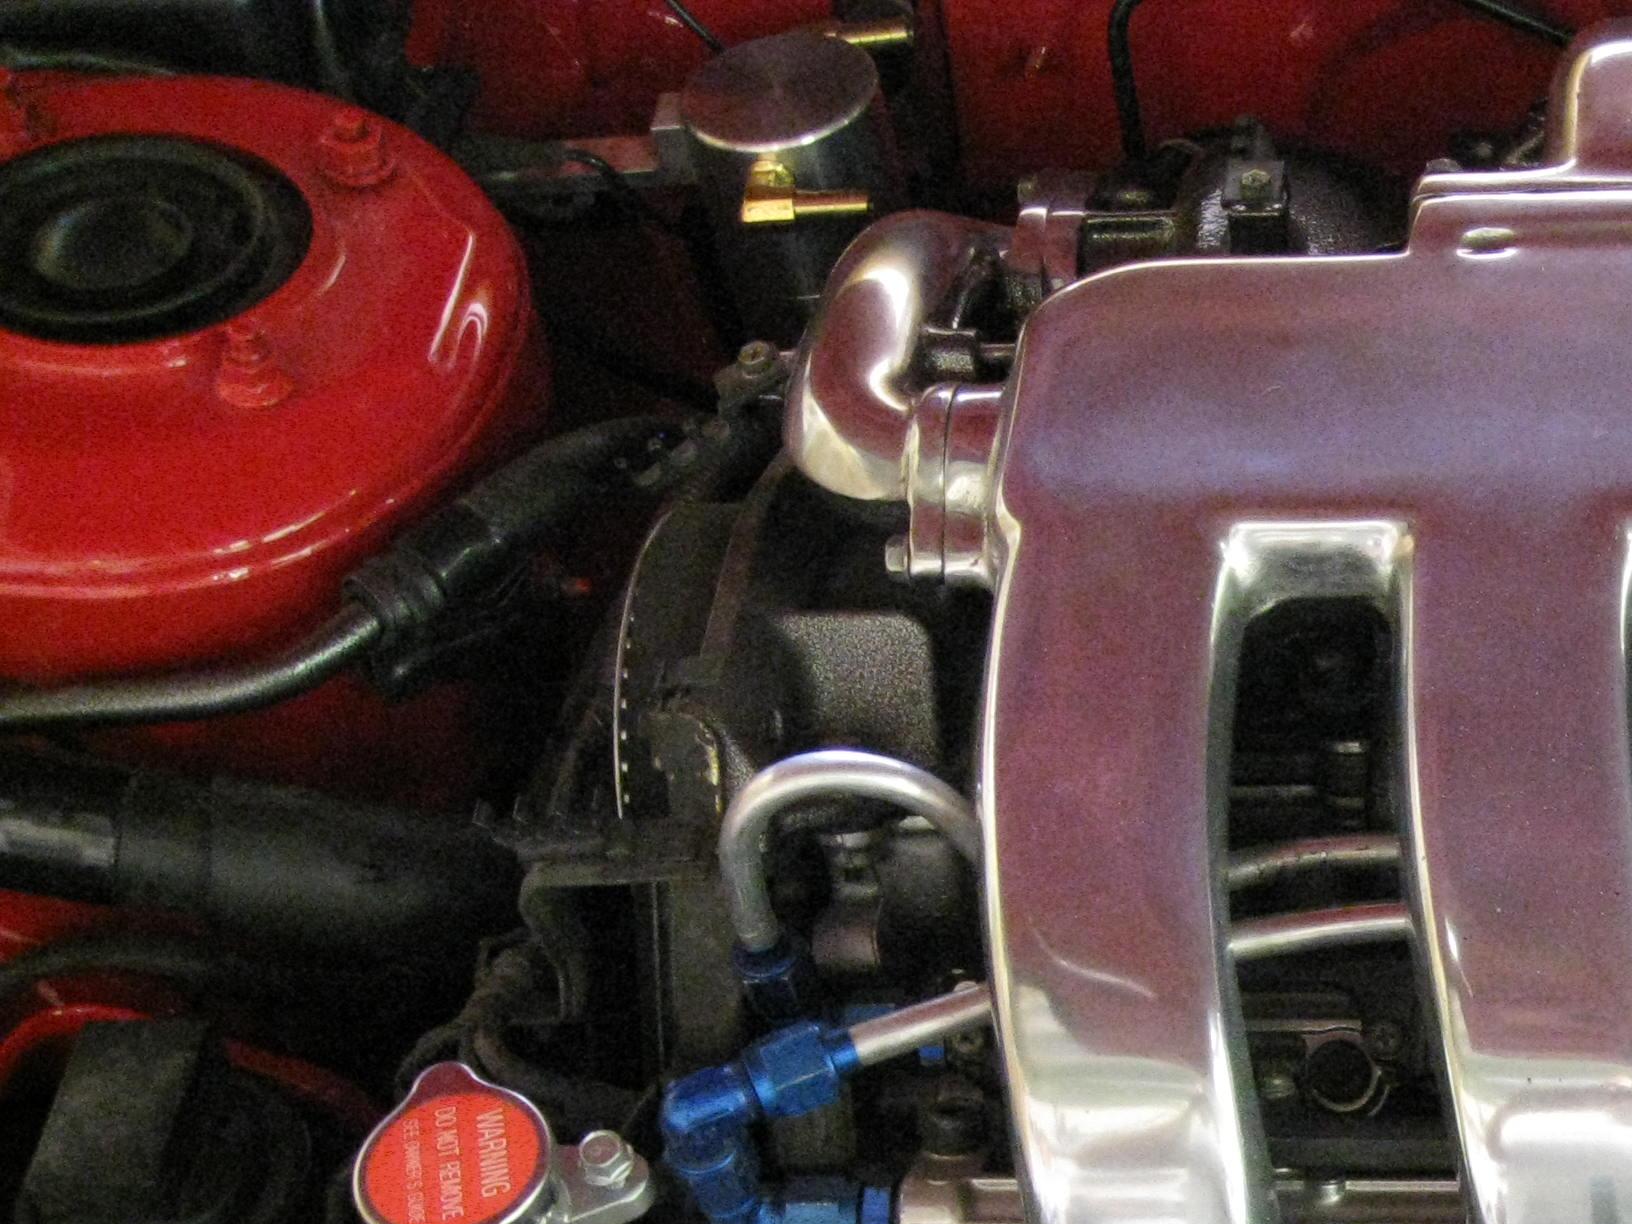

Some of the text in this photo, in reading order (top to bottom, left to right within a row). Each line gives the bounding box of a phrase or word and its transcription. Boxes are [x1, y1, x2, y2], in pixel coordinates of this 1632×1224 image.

[402, 1118, 420, 1140] SEE
[434, 1106, 465, 1221] DO NOT REMOVE
[476, 1108, 512, 1198] WARNING
